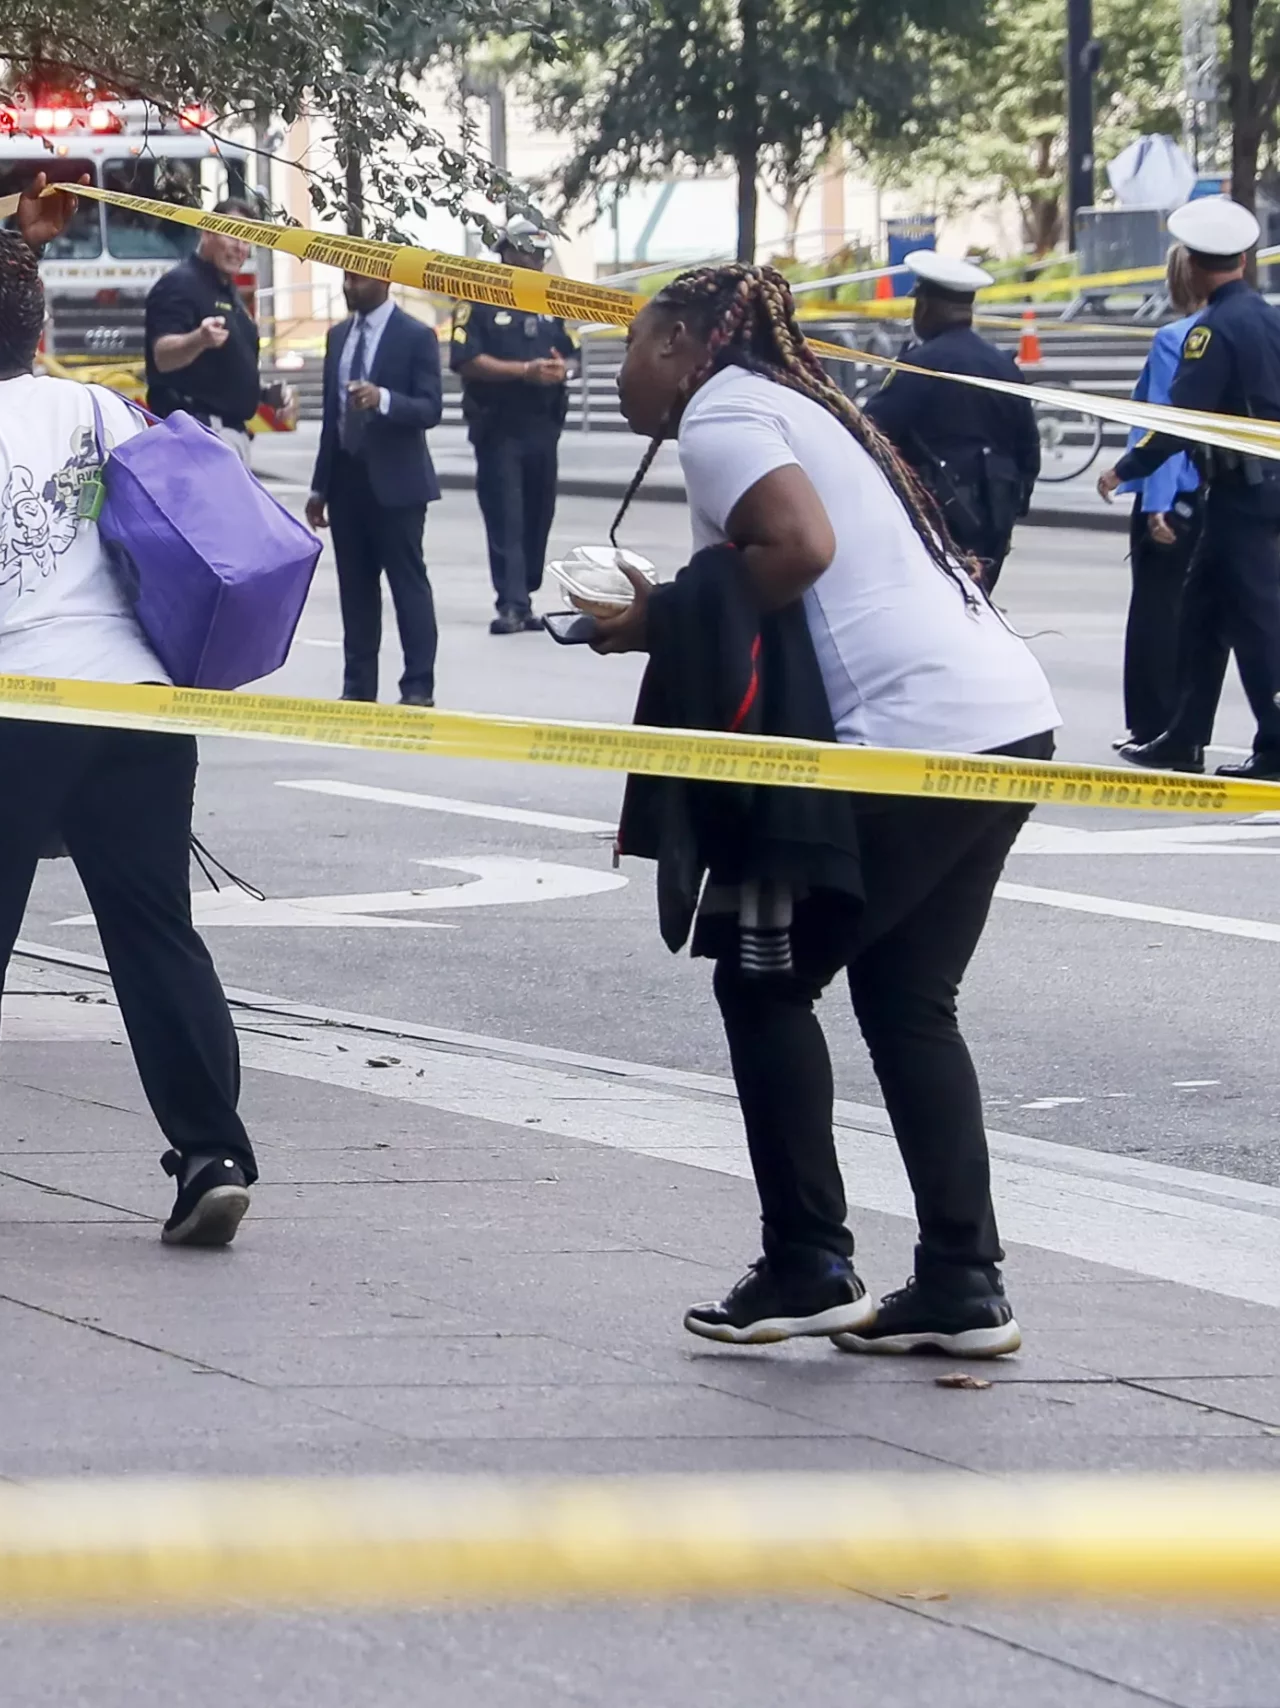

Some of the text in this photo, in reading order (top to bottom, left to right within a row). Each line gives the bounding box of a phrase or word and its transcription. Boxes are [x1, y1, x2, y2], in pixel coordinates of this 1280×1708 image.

[217, 220, 237, 234] NOT
[231, 222, 245, 237] DO
[240, 226, 259, 239] LINE
[254, 230, 282, 246] POLICE
[302, 243, 329, 262] CROSS
[326, 248, 345, 268] NOT
[344, 252, 355, 270] DO
[351, 254, 369, 274] LINE
[366, 258, 393, 278] POLICE
[422, 272, 446, 293] CROSS
[447, 277, 462, 296] NOT
[461, 281, 474, 299] DO
[472, 283, 491, 302] LINE
[489, 286, 518, 307] POLICE
